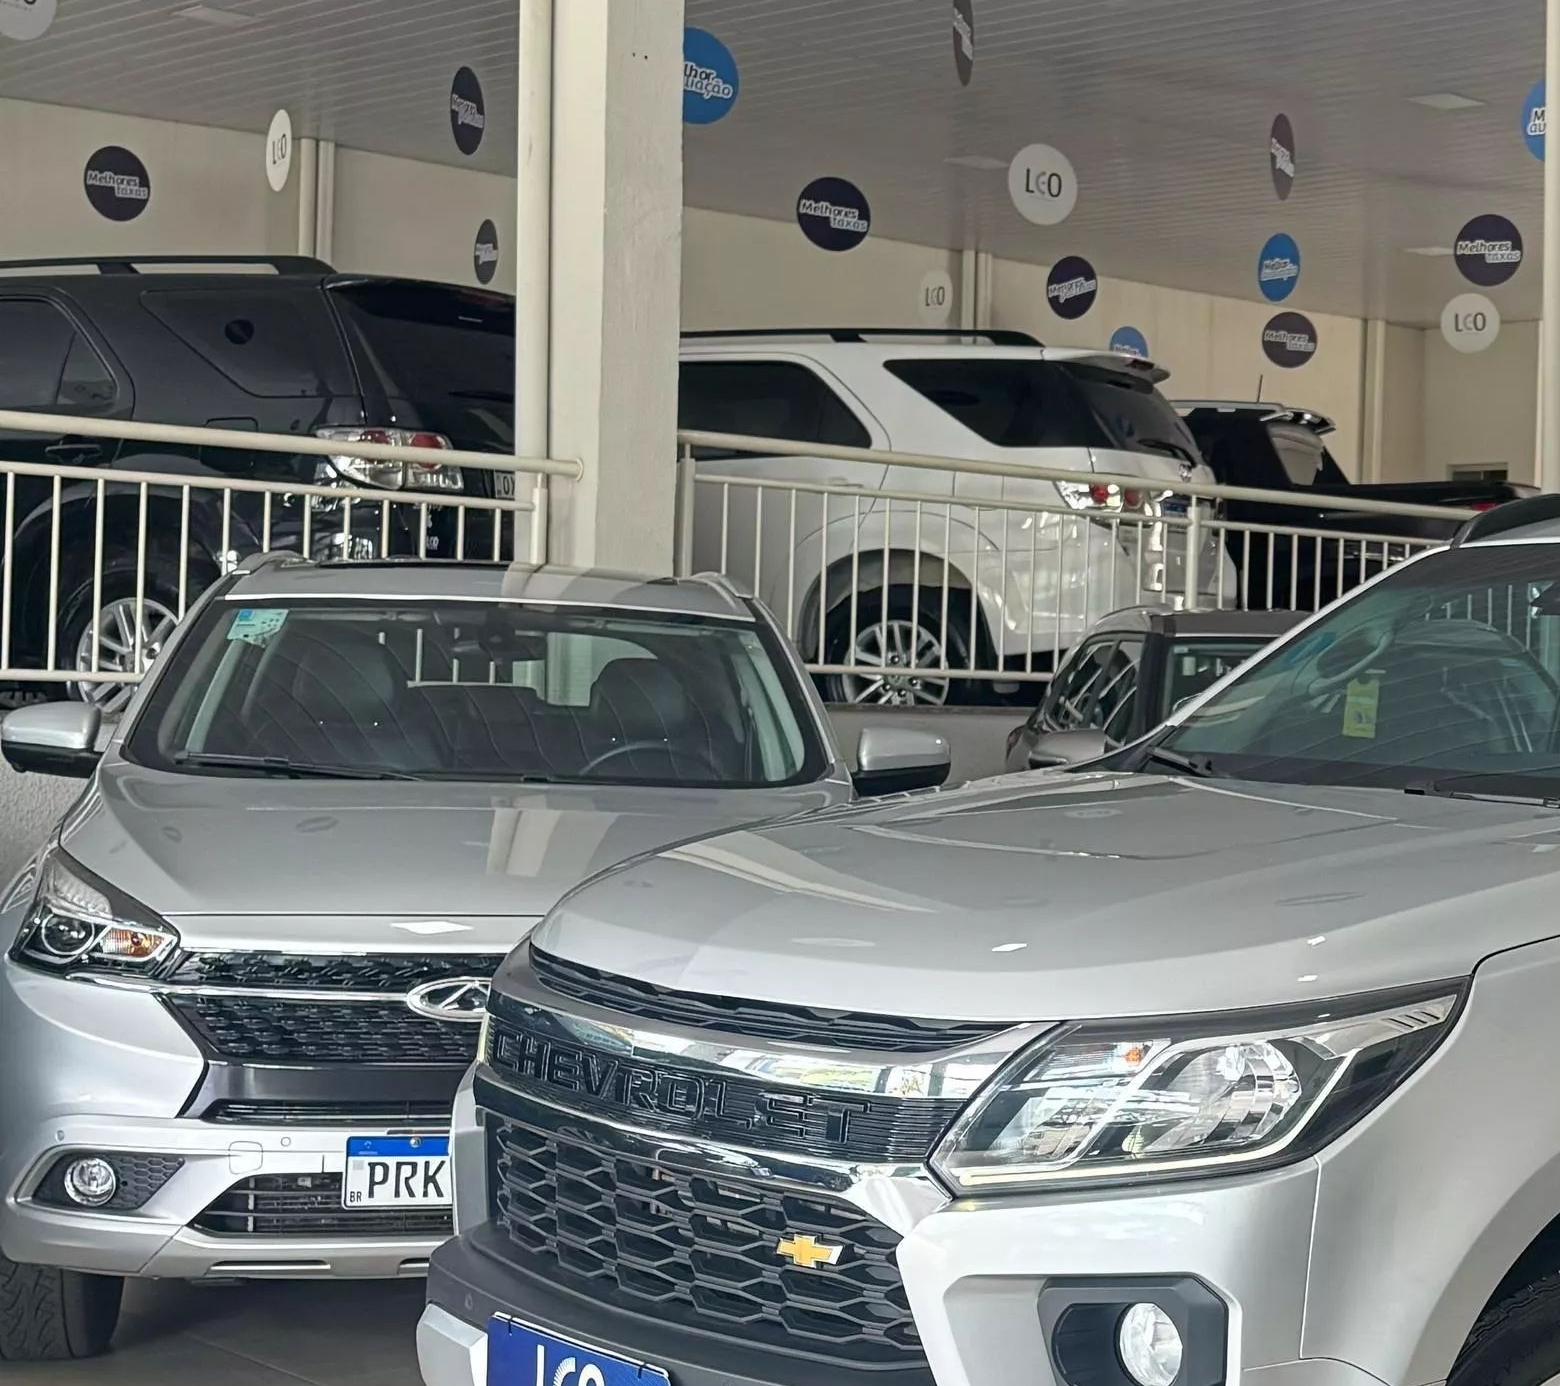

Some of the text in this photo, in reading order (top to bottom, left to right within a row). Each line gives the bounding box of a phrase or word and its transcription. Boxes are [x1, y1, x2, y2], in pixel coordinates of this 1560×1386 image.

[87, 171, 138, 186] Melhores
[800, 200, 858, 219] Melhores
[830, 217, 867, 231] taxas
[1458, 240, 1511, 253] Melhores
[497, 1028, 870, 1144] CHEVROLET
[367, 1160, 446, 1199] PRK
[349, 1190, 362, 1203] BR
